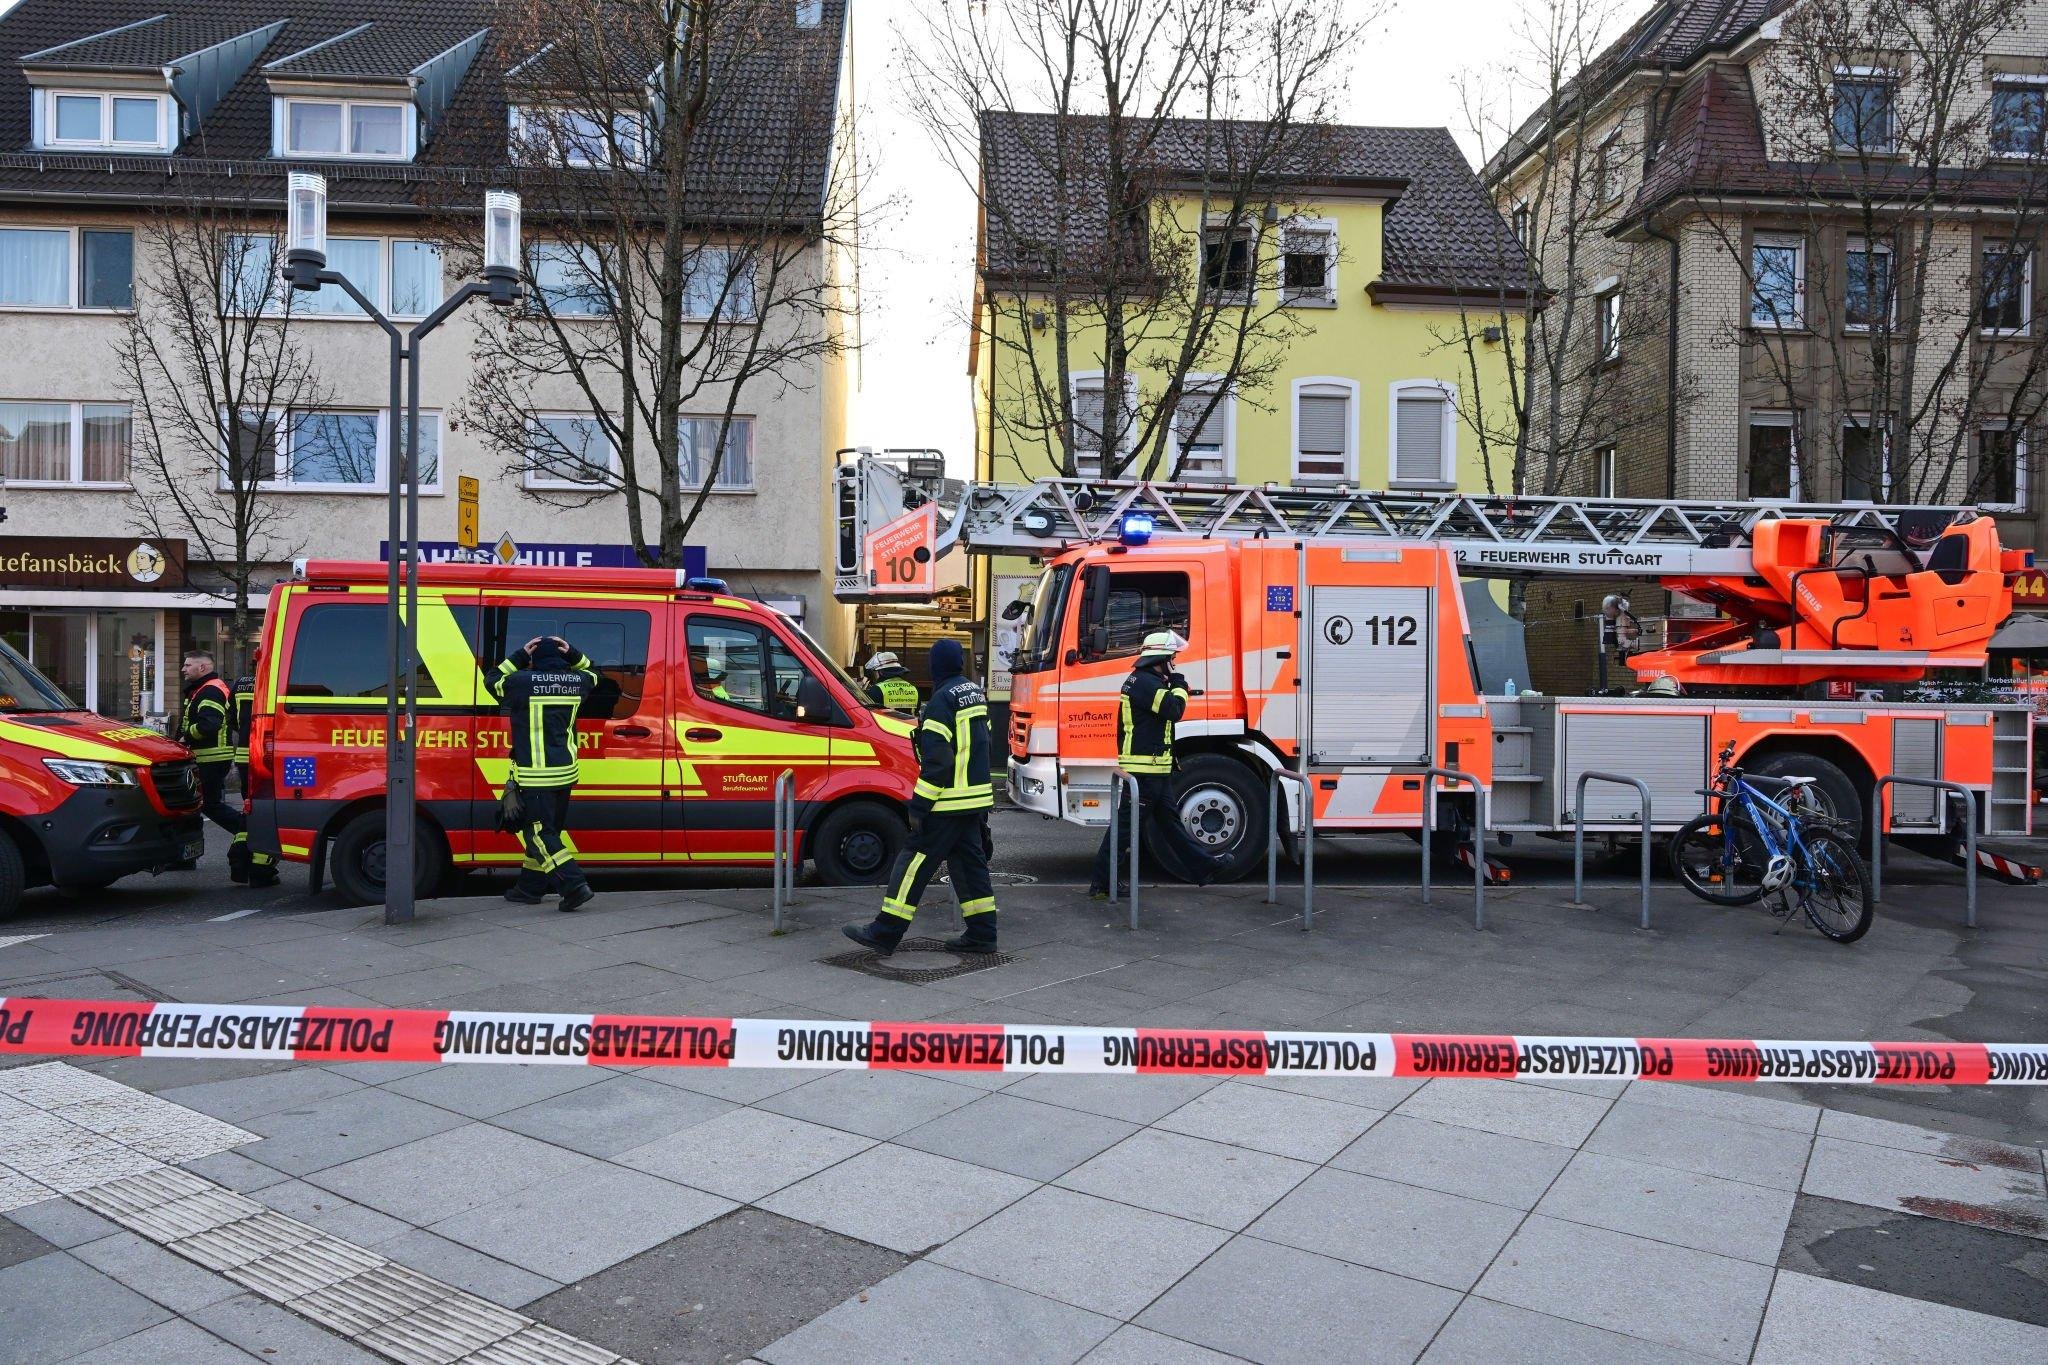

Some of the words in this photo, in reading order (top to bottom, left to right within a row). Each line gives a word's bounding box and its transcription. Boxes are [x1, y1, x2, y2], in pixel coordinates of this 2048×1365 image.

[874, 522, 921, 551] FEUERWEHR
[881, 531, 924, 559] STUTTGART
[0, 552, 122, 574] tefansbäck
[1481, 550, 1570, 564] FEUERWEHR
[1578, 548, 1662, 566] STUTTGART
[886, 557, 916, 582] 10
[2014, 576, 2045, 597] 44
[1365, 615, 1418, 646] 112
[531, 674, 581, 682] FEUERWEHR
[532, 683, 580, 695] STUTTGART
[1988, 677, 2032, 685] Vorbestellun
[1068, 711, 1113, 722] STUTTGART
[331, 728, 467, 749] FEUEWEHR
[476, 730, 604, 749] STURT
[293, 768, 307, 776] 112
[722, 773, 768, 783] STUTTGART
[71, 1010, 394, 1053] POLIZEIABSPERRUNG
[433, 1019, 738, 1060] POLIZEIABSPERRUNG
[777, 1028, 1065, 1066] POLIZEIABSPERRUNG
[1103, 1035, 1377, 1071] POLIZEIABSPERRUNG
[1412, 1041, 1674, 1077] POLIZEIABSPERRUNG
[1705, 1047, 1955, 1080] POLIZEIABSPERRUNG
